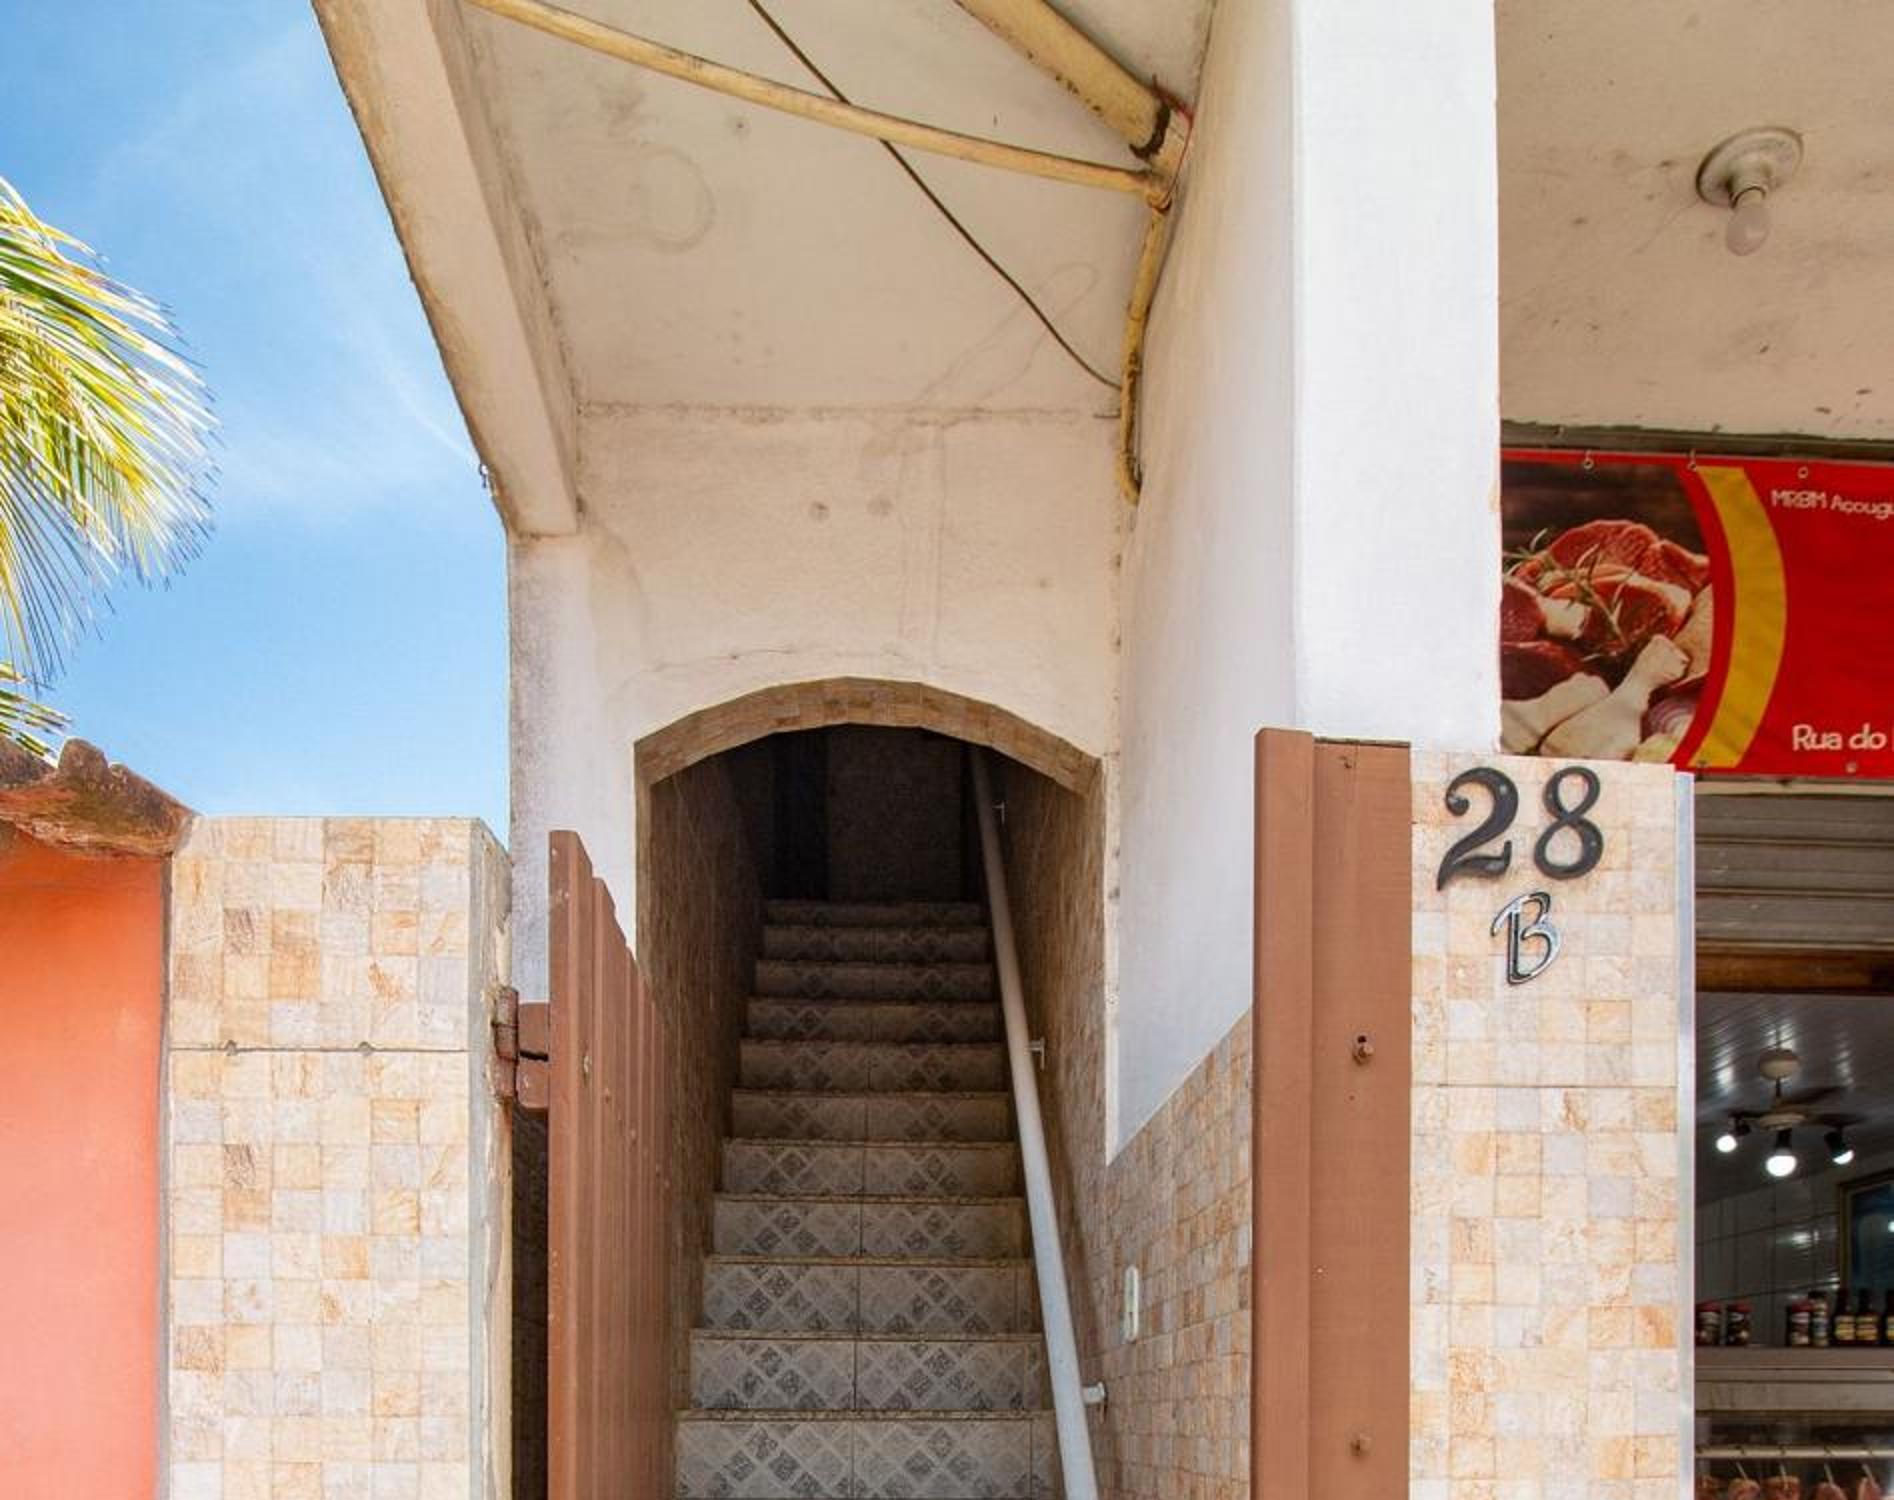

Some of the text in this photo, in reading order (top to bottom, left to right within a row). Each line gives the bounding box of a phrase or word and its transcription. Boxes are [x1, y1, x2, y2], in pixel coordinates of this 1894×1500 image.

[1792, 723, 1842, 751] Rua
[1849, 722, 1887, 750] do
[1436, 766, 1604, 891] 28
[1490, 890, 1563, 986] B
